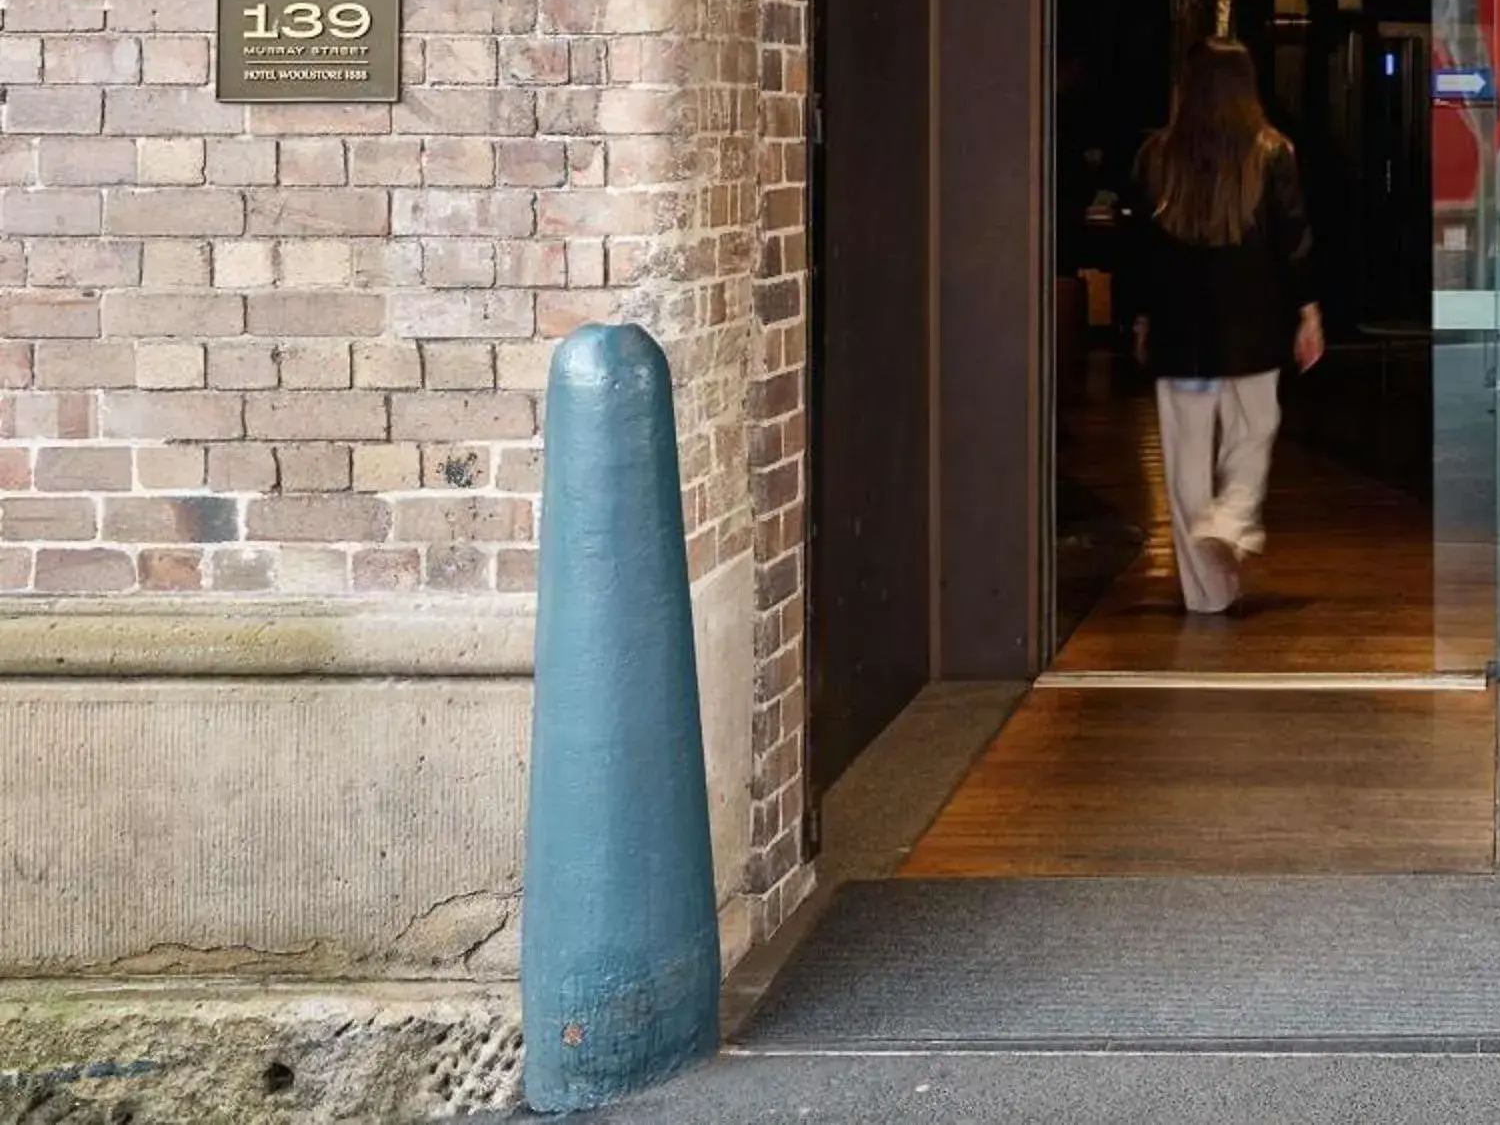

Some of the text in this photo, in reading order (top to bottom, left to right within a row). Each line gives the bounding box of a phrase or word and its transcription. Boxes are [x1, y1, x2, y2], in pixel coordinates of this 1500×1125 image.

[243, 2, 372, 39] 139
[243, 46, 369, 56] MURRAY STREET
[243, 69, 277, 80] HOTEL
